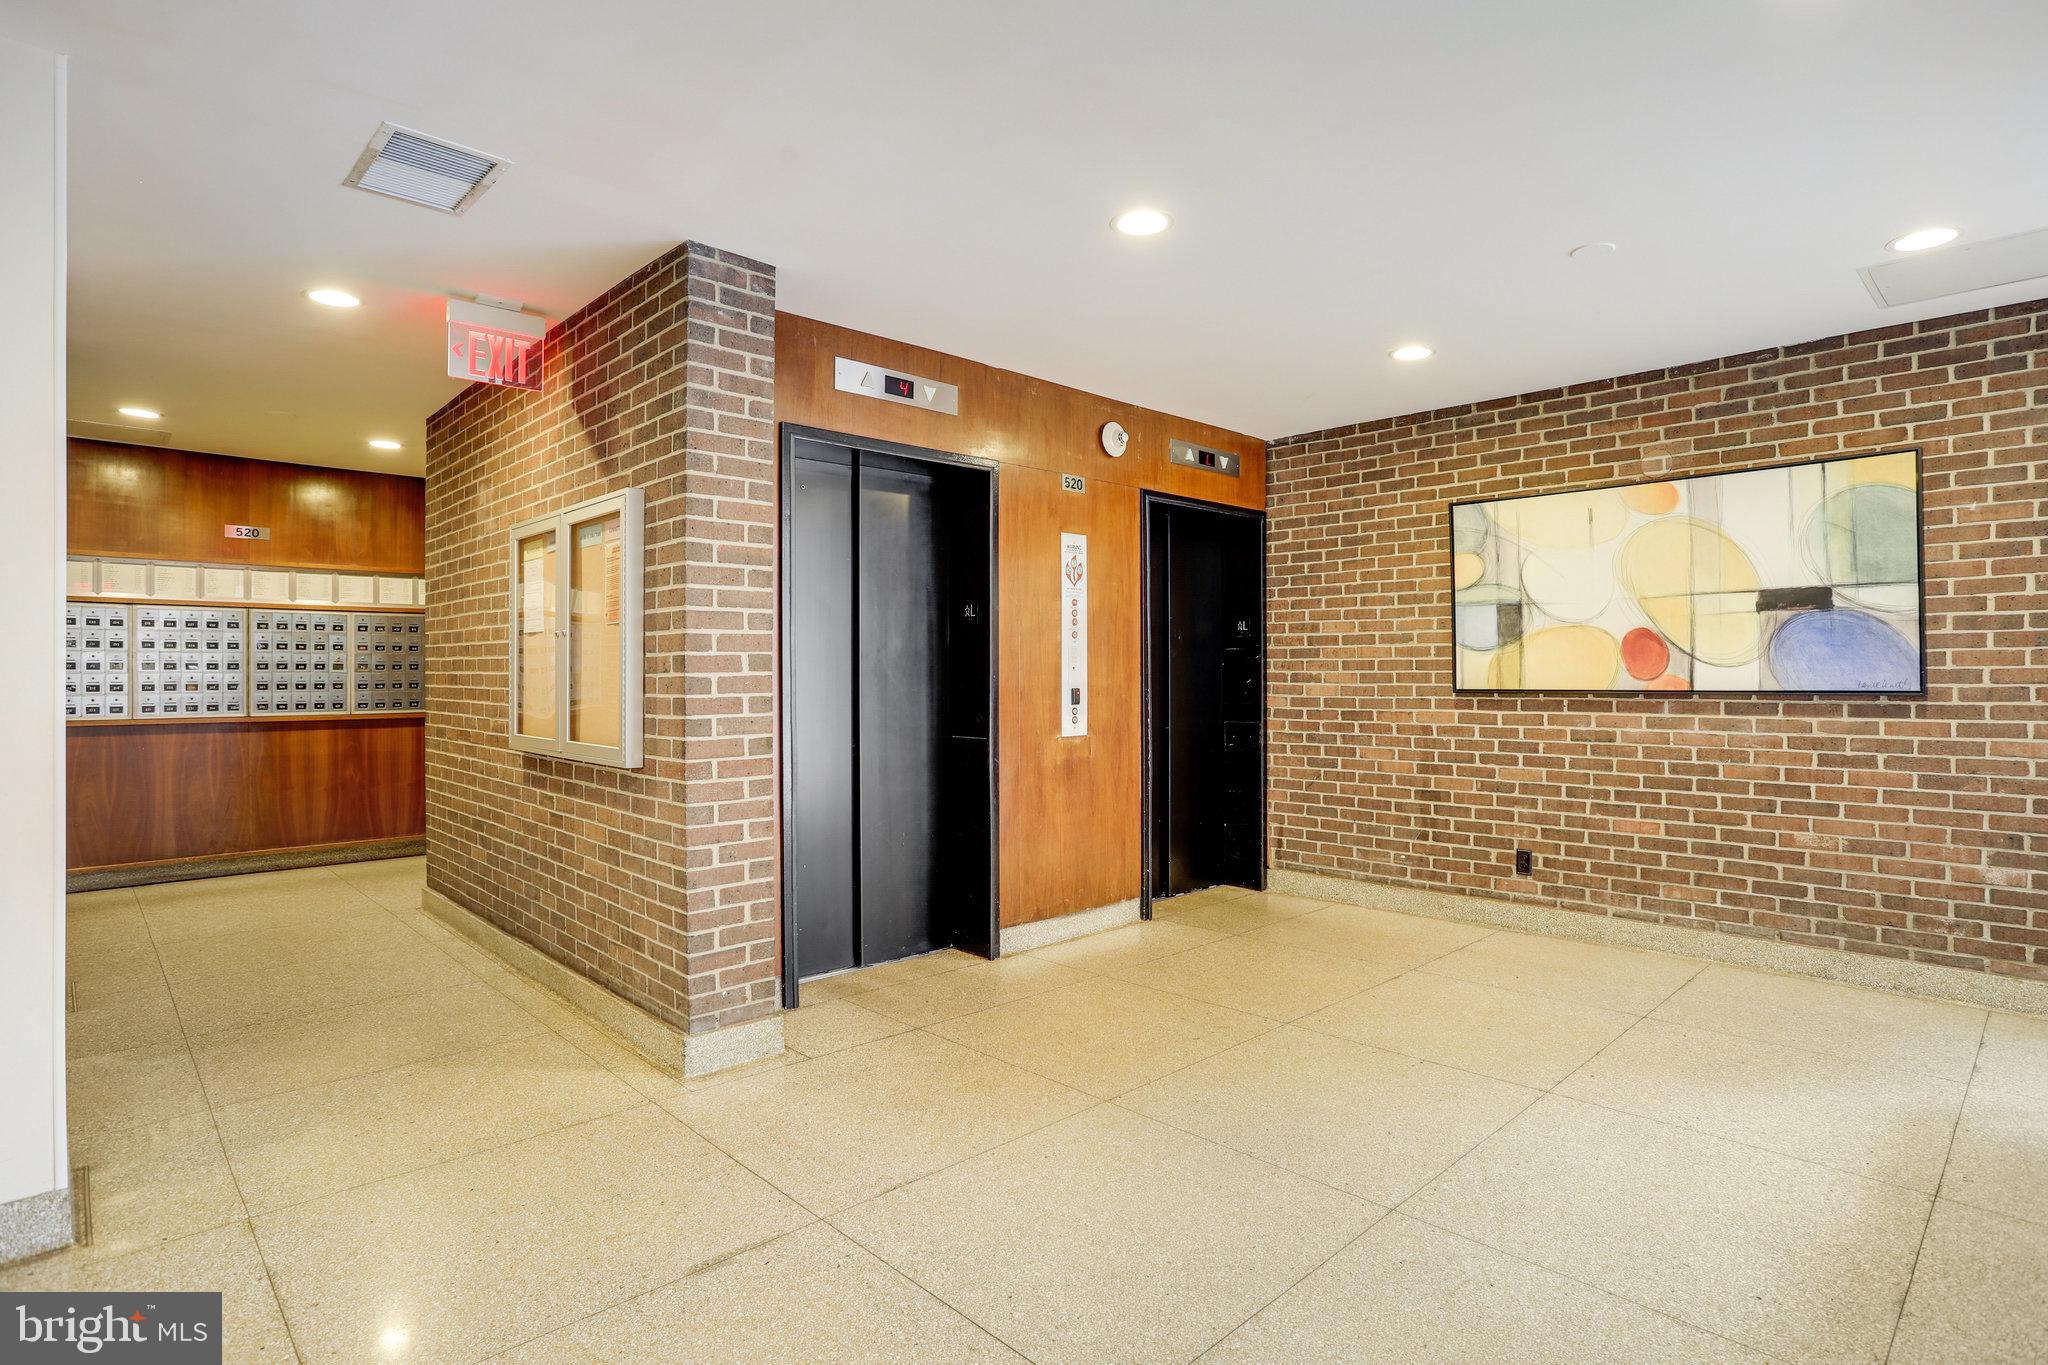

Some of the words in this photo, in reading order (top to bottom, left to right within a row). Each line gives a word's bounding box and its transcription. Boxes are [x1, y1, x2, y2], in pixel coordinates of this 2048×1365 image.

[467, 330, 531, 385] EXIT
[899, 381, 909, 396] 4
[1064, 476, 1083, 491] 520
[236, 527, 260, 538] 520
